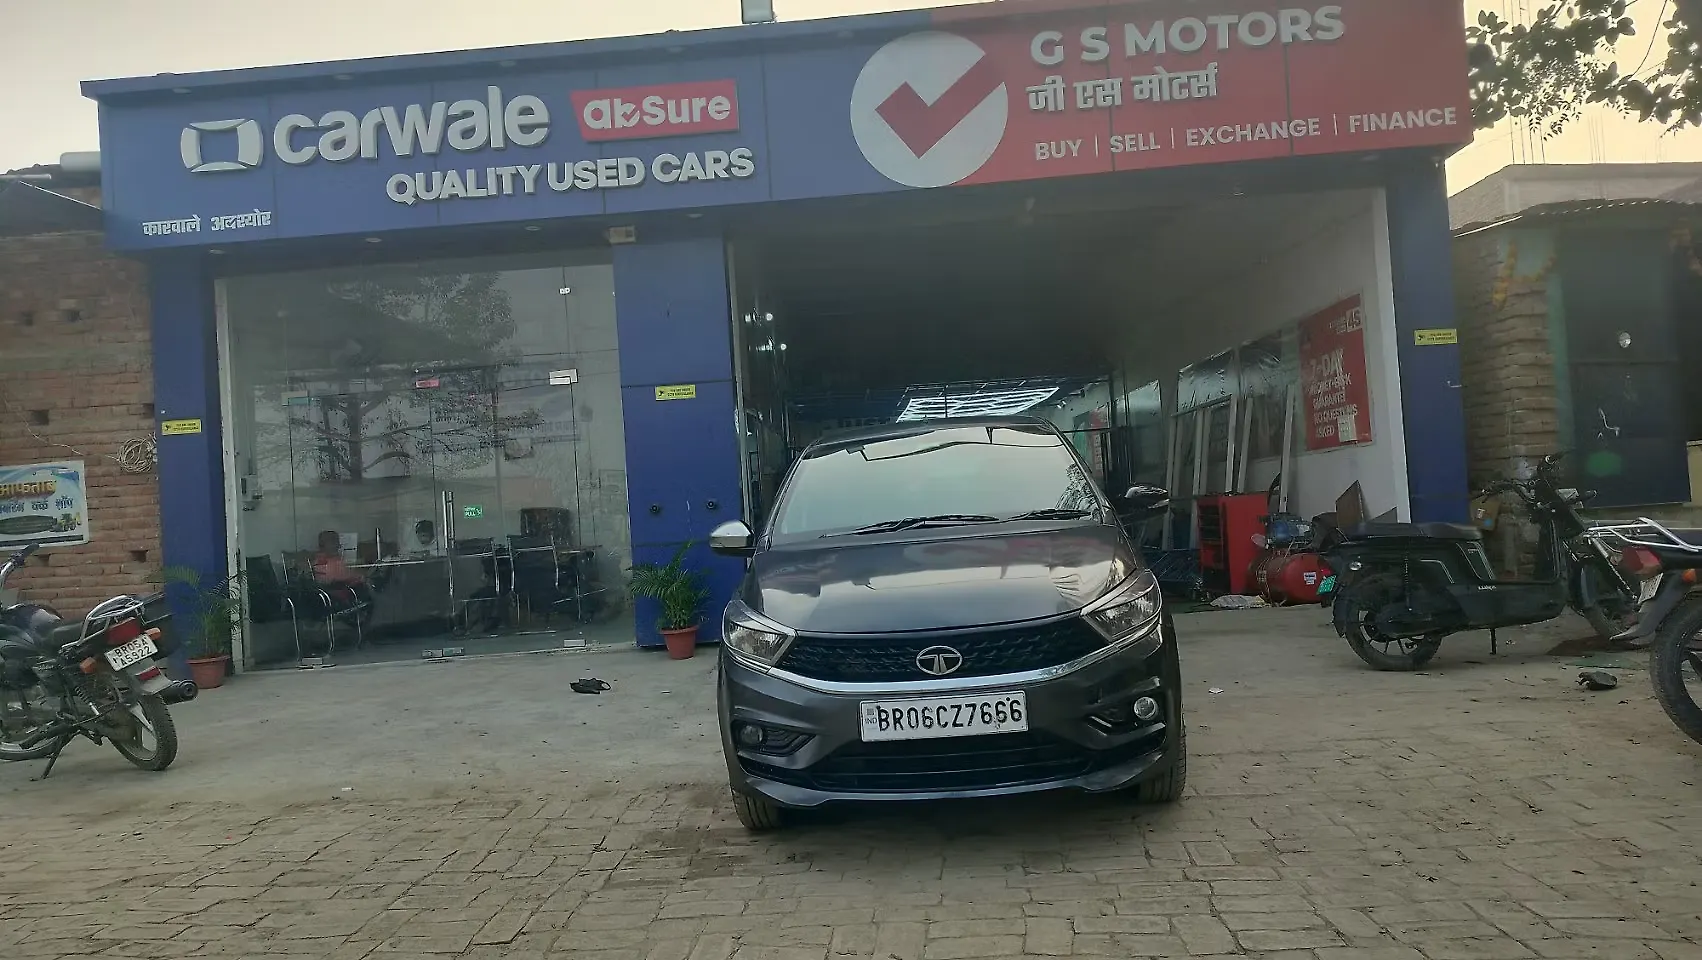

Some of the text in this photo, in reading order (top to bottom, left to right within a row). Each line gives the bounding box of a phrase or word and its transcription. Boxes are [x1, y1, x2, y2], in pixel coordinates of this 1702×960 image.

[1030, 5, 1344, 65] G S MOTORS
[1025, 62, 1218, 112] जी एस मोटर्स
[273, 85, 550, 165] carwale
[1034, 106, 1457, 161] BUY SELL EXCHANGE FINANCE
[386, 147, 755, 206] QUALITY USED CARS
[142, 214, 201, 236] कारवाले
[877, 699, 1022, 732] BR06CZ7666
